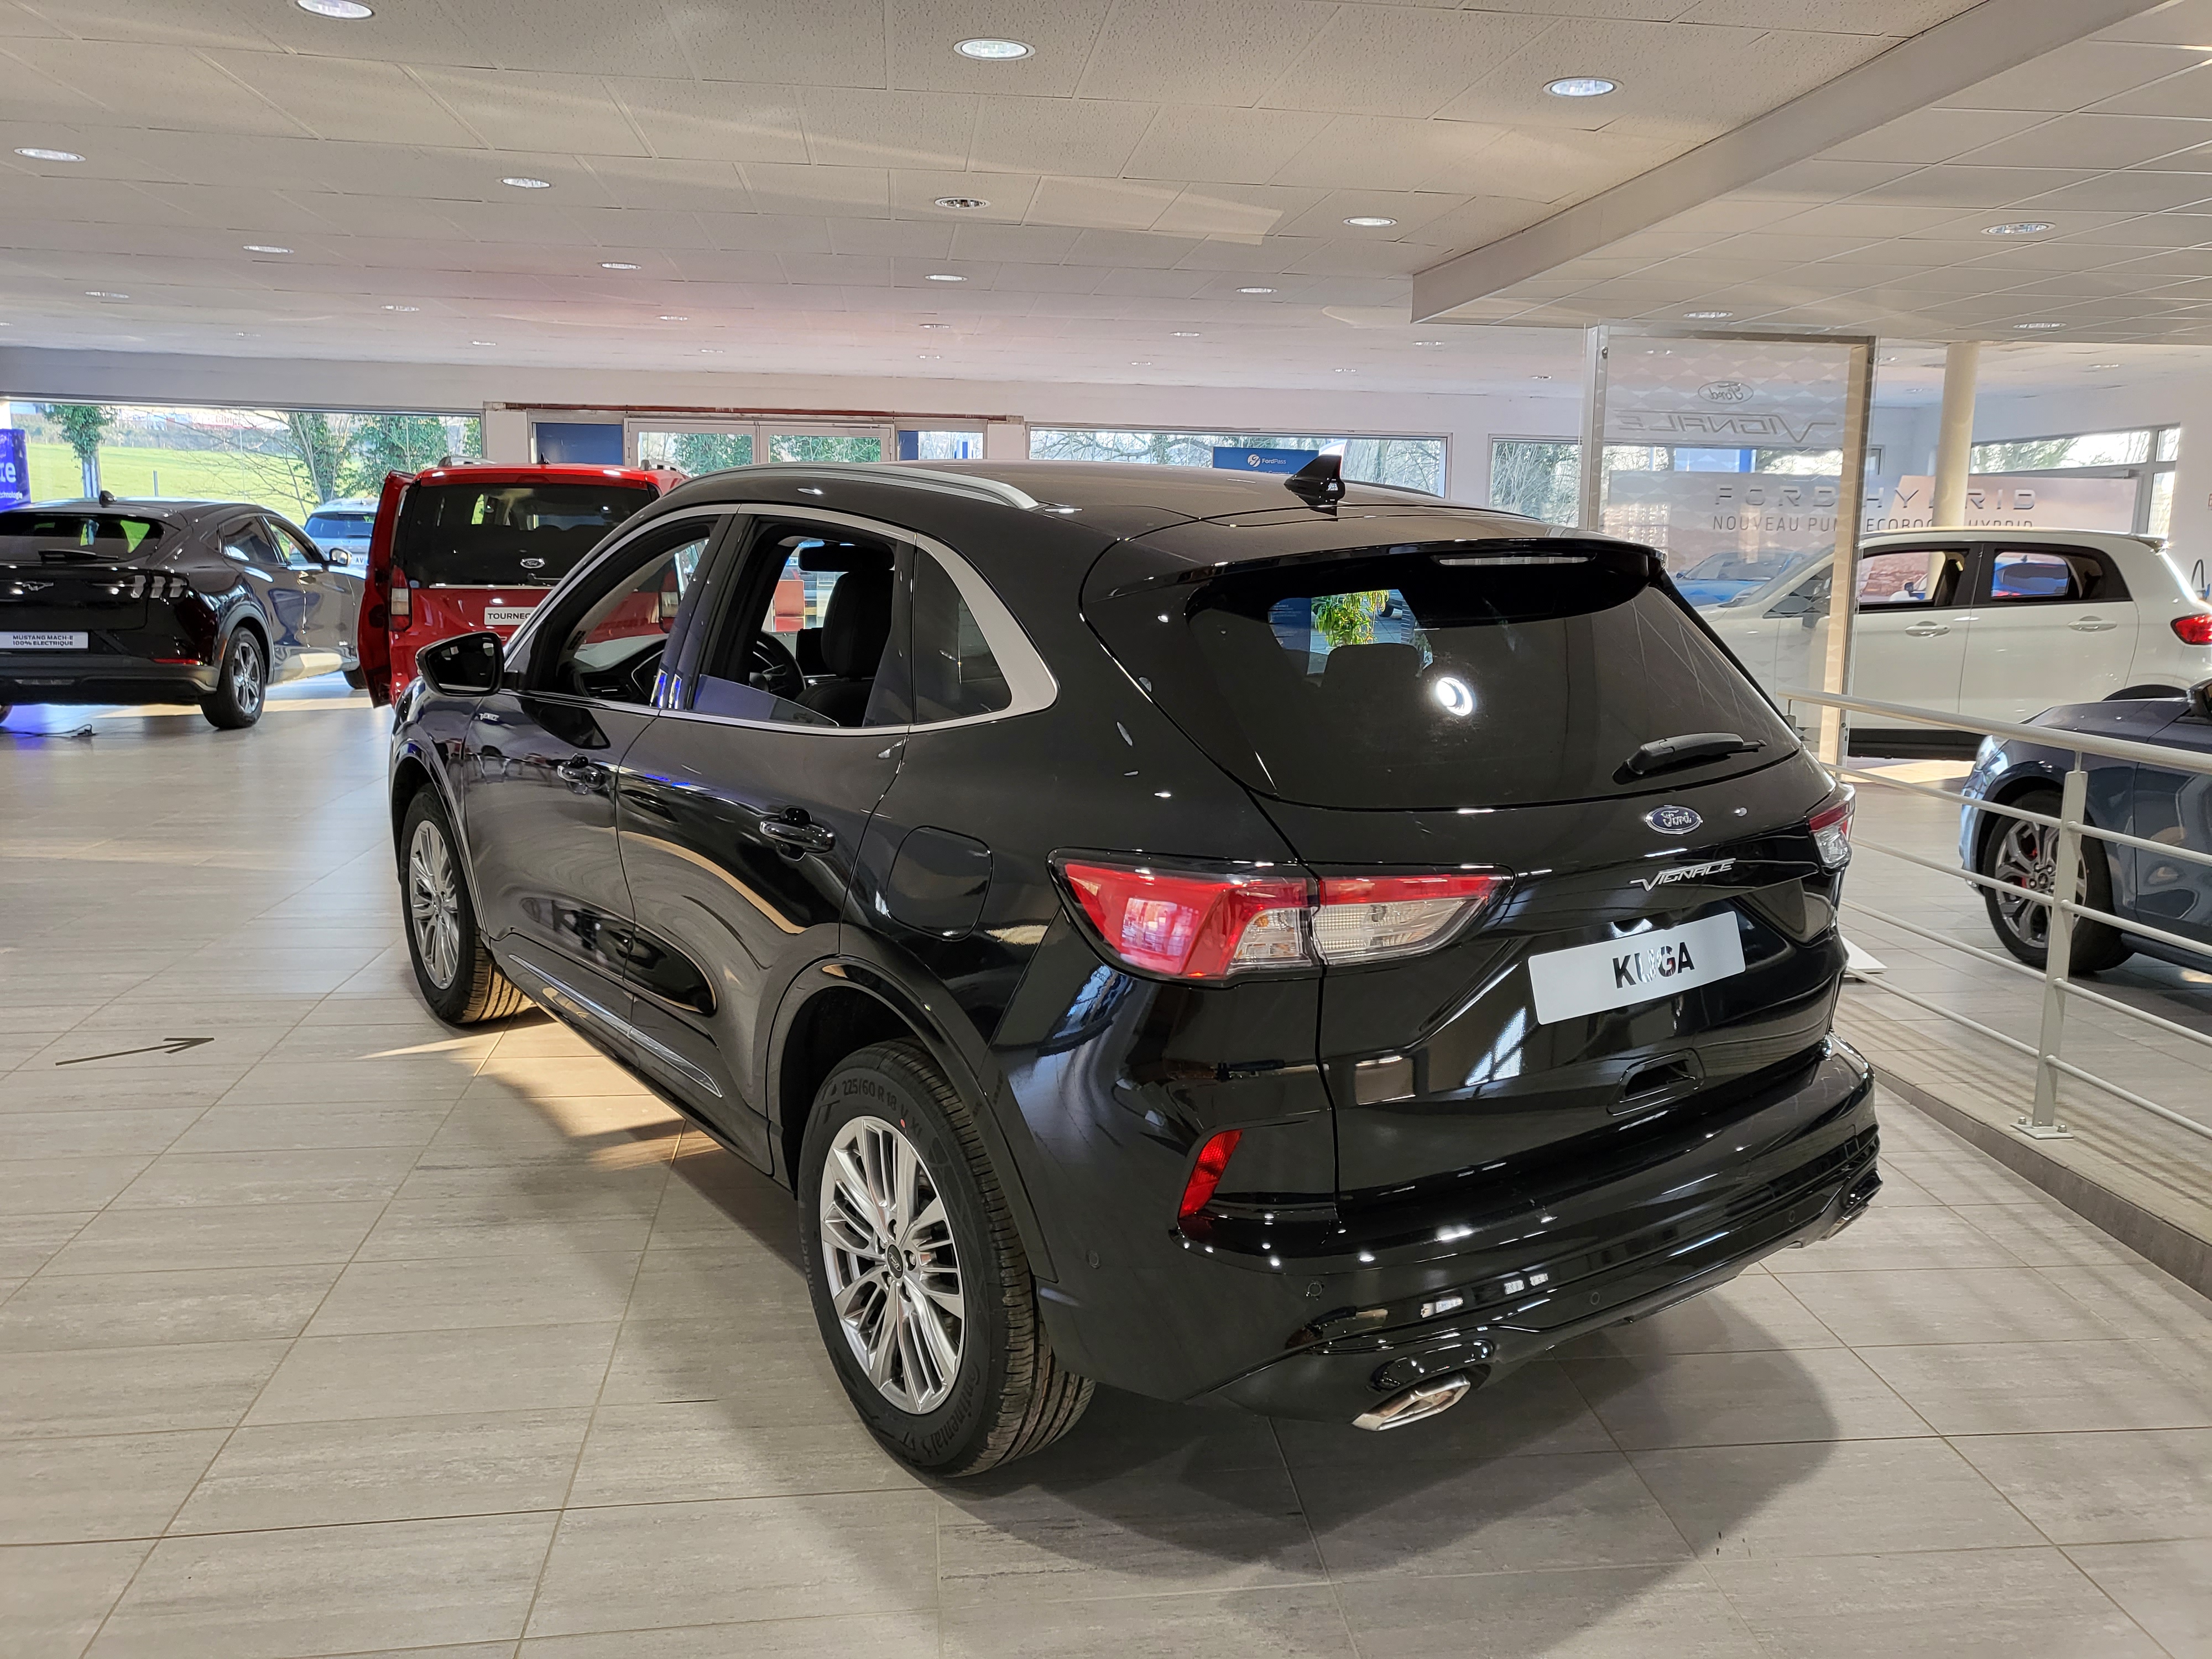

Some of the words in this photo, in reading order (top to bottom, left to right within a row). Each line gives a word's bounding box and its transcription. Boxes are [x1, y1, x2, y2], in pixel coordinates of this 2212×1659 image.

[1715, 484, 1836, 507] FORD
[1862, 487, 2036, 510] HYRID
[1713, 515, 1799, 531] NOUVEAU
[1808, 517, 1837, 531] PU
[1866, 519, 1933, 532] ECOBO
[1629, 858, 1736, 891] VIGNALE
[1613, 942, 1695, 989] KUGA
[842, 1078, 875, 1097] 225/60
